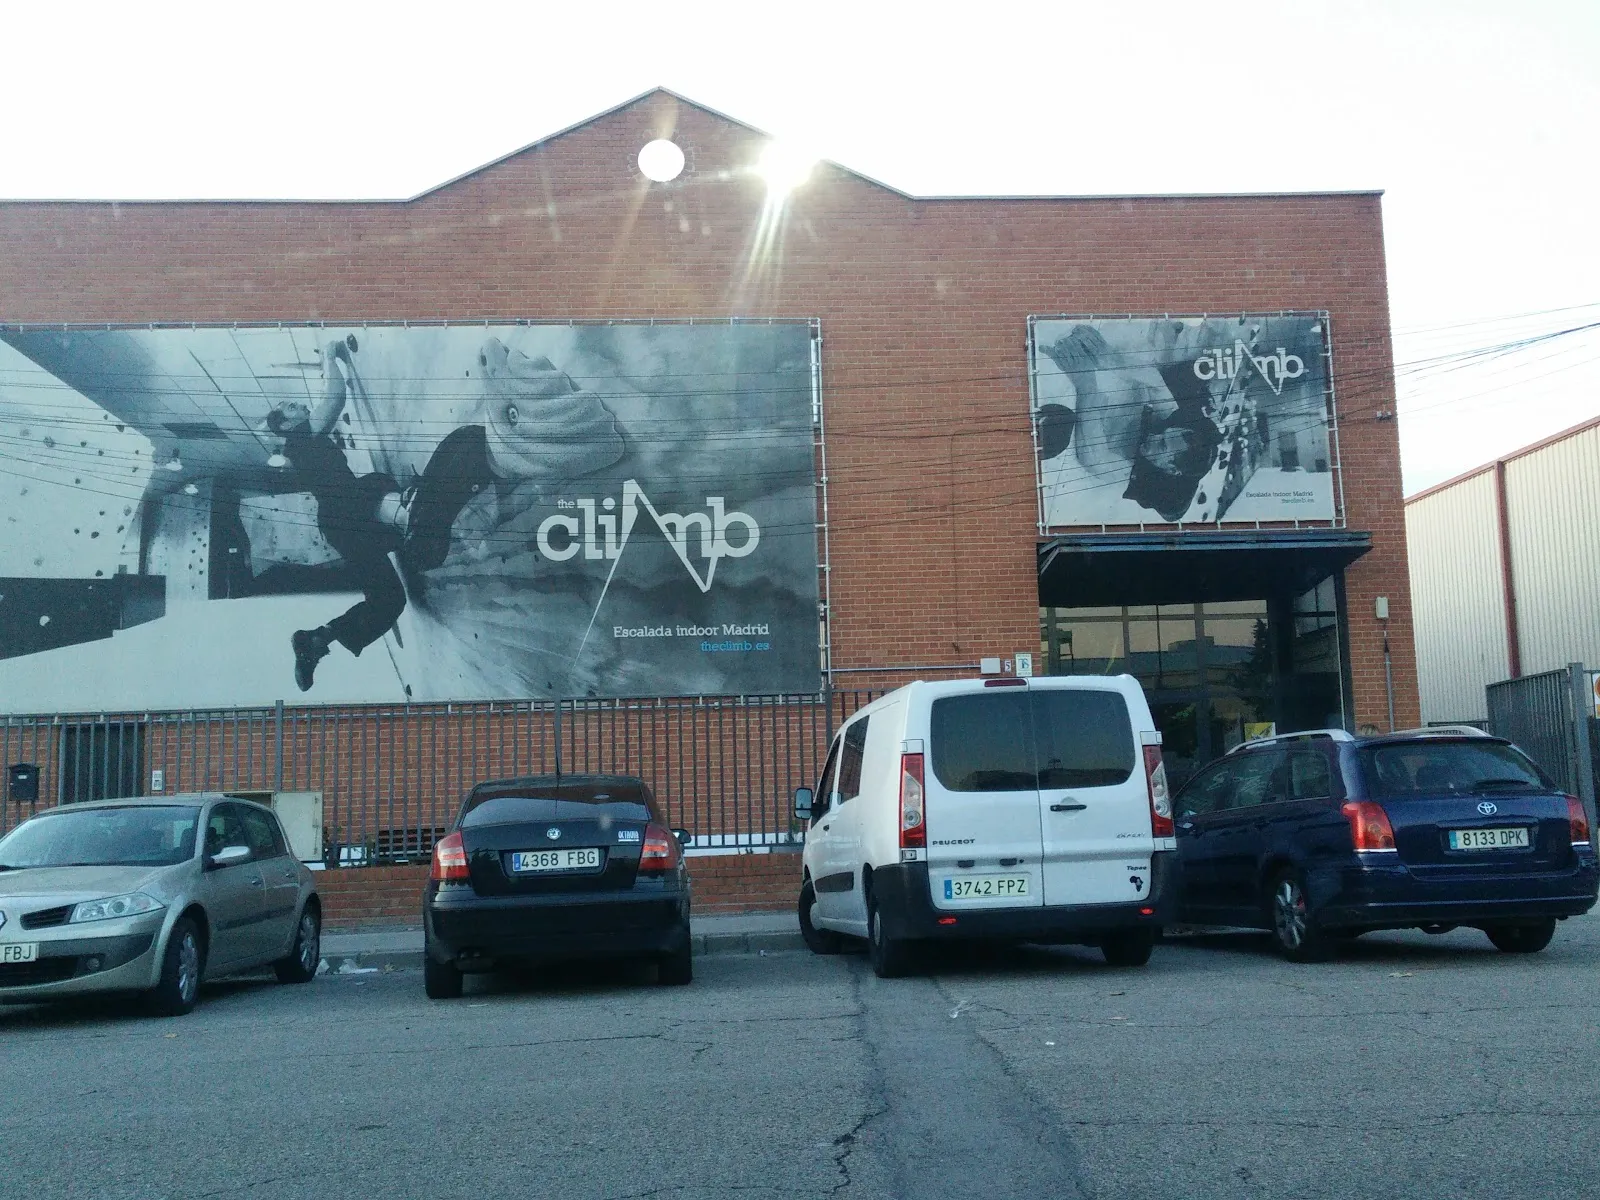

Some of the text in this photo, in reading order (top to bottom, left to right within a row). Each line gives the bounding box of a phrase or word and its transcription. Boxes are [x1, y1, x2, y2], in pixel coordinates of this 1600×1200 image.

[557, 498, 575, 509] the
[536, 479, 761, 593] climb
[613, 624, 770, 638] Escalada indoor Madrid
[701, 641, 770, 651] theclimb.es
[1463, 831, 1522, 846] 8133 DPK
[522, 852, 596, 868] 4368 FBG
[954, 880, 1026, 896] 3742 FPZ
[4, 945, 32, 960] FBJ
